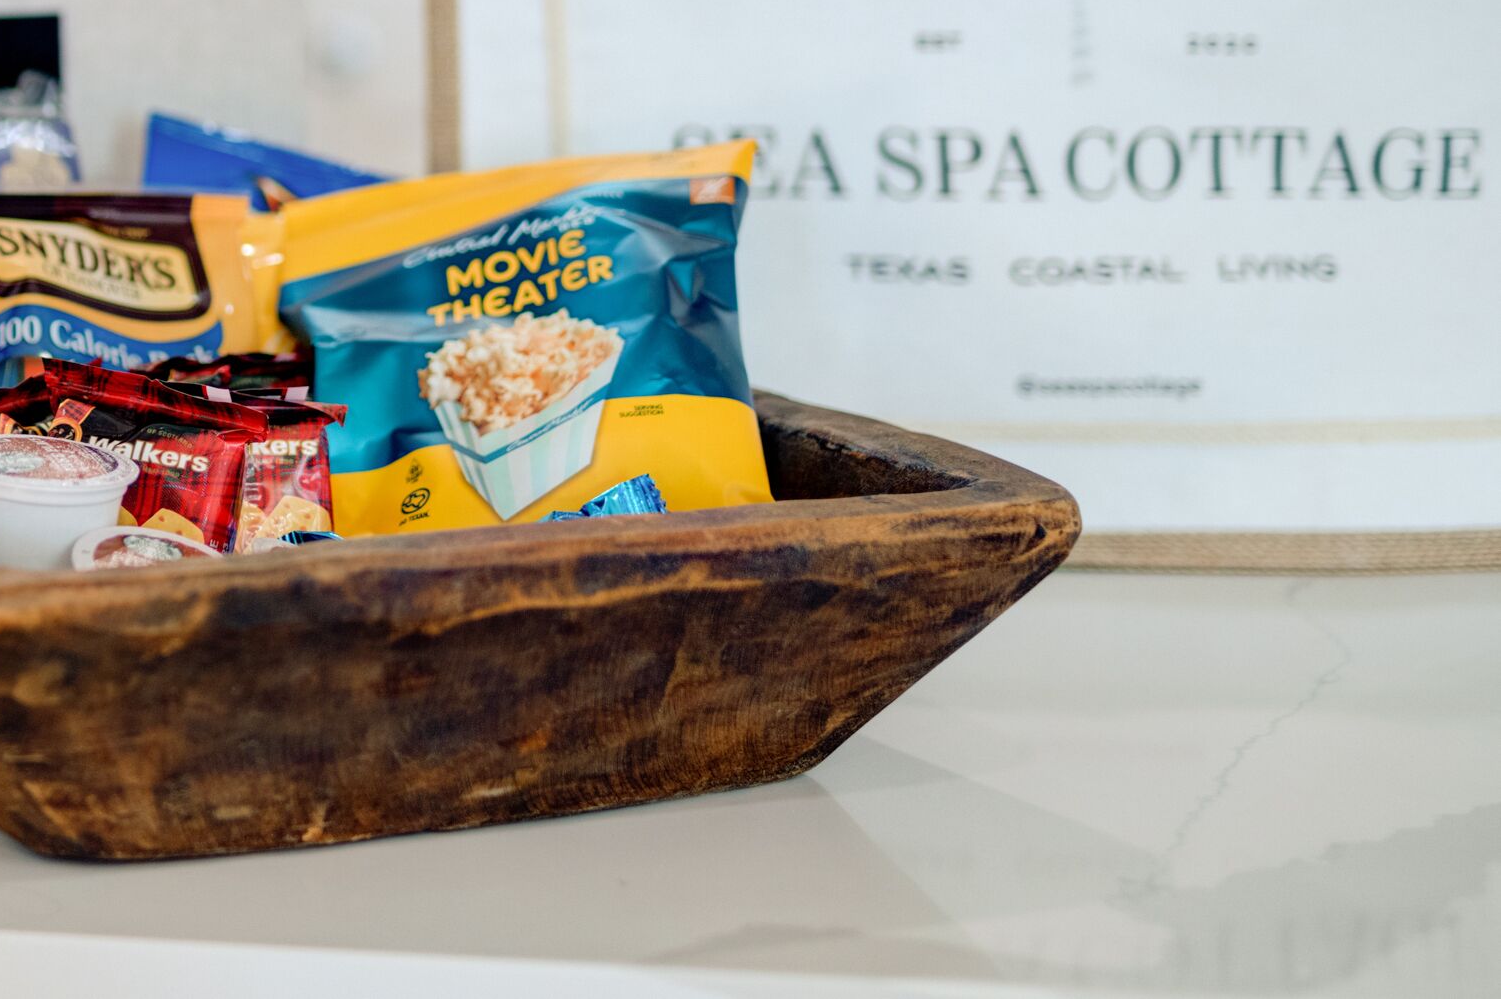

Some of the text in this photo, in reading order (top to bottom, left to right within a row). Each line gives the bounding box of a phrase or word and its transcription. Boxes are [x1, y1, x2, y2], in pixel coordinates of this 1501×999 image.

[875, 124, 1045, 201] SPA
[1066, 126, 1481, 201] COTTAGE
[445, 228, 587, 296] MOVIE
[846, 253, 1338, 286] TEXAS COASTAL LIVING
[427, 254, 614, 327] THEATER
[88, 435, 209, 473] Walkers
[246, 439, 319, 456] kers
